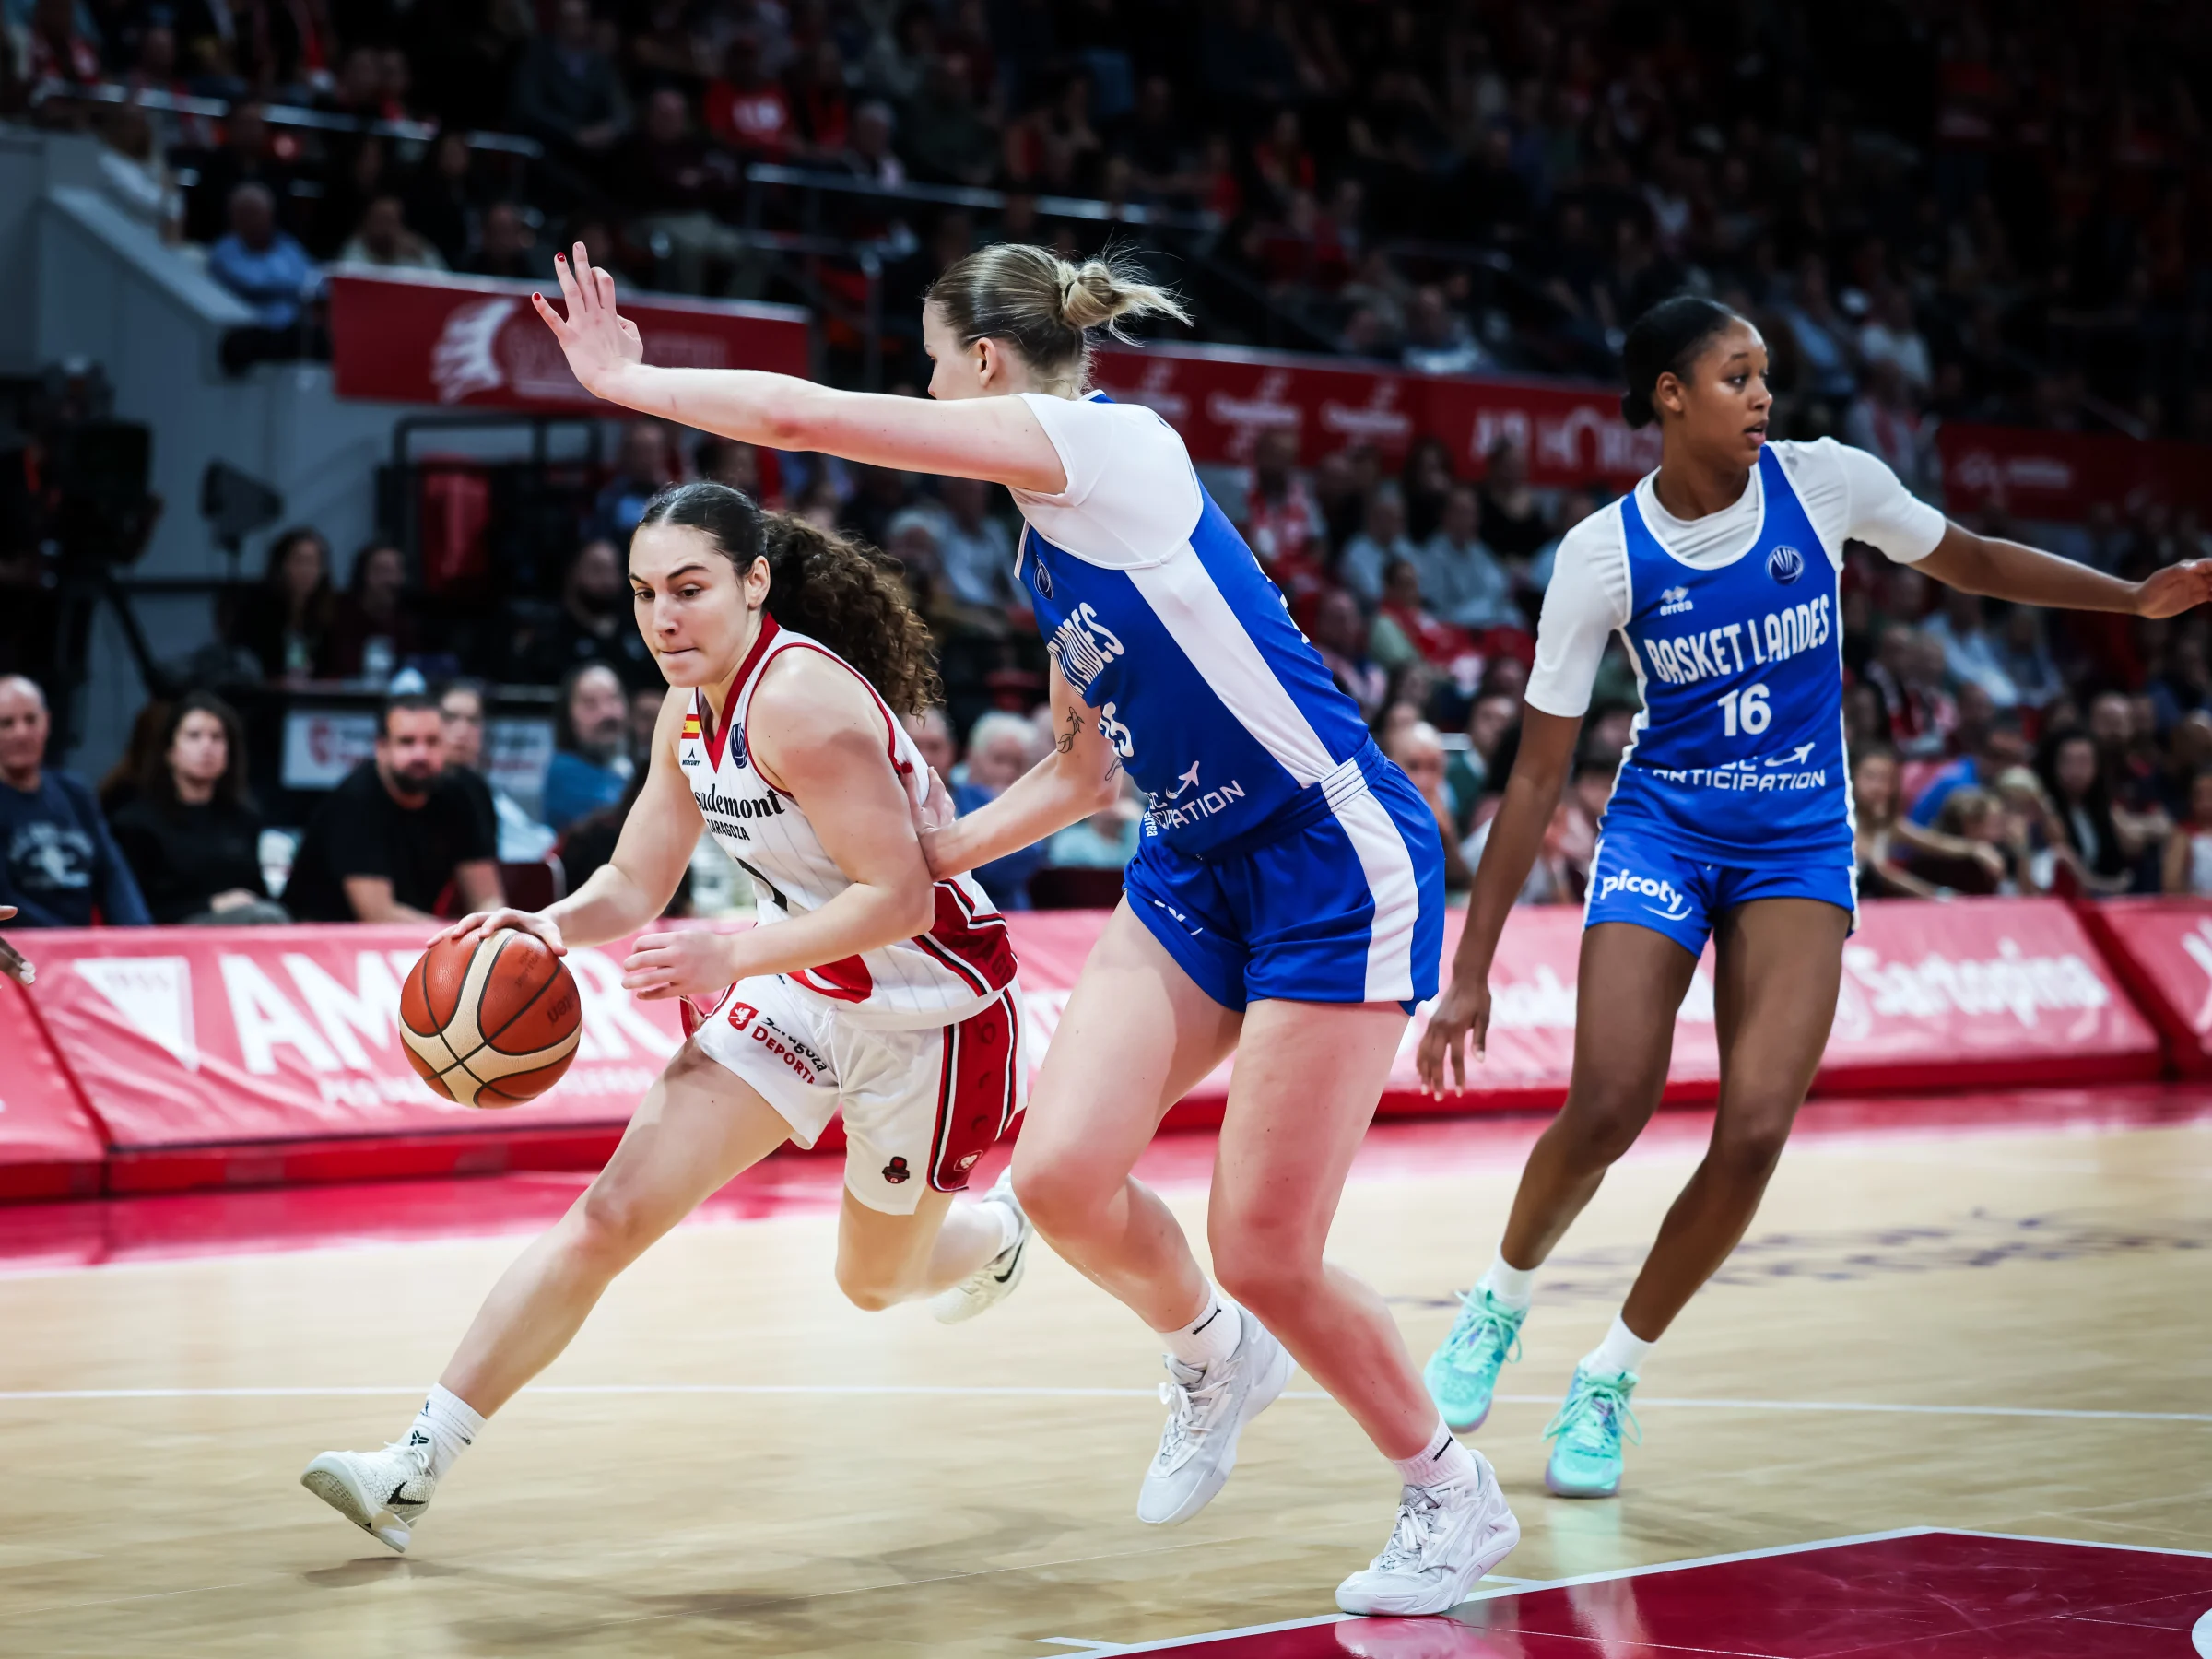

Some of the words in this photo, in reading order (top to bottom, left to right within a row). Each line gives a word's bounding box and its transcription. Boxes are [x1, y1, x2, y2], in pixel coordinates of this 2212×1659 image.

[1644, 623, 1744, 684] BASKET
[1747, 594, 1830, 665] LANDES
[1717, 683, 1771, 737] 16
[694, 783, 785, 818] sademont
[1600, 868, 1683, 913] picoty
